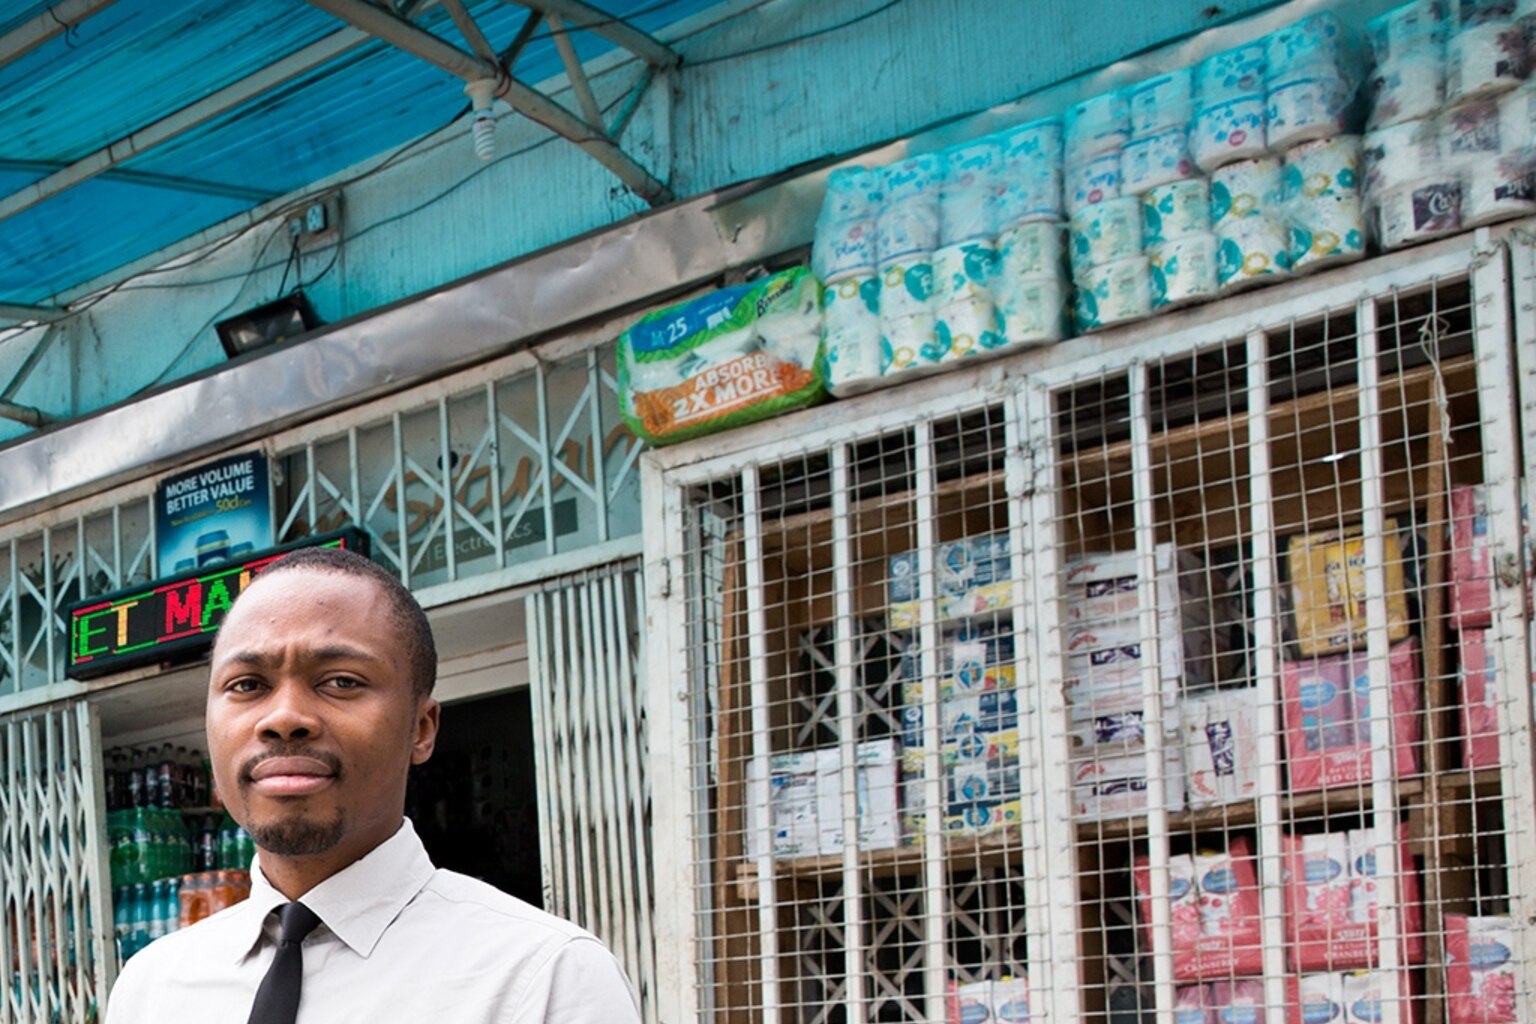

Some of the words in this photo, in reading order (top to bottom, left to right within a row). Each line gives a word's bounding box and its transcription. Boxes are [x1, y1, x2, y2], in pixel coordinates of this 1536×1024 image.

[667, 317, 688, 343] 25
[672, 391, 713, 418] 2X
[166, 476, 199, 499] MORE
[199, 460, 254, 486] VOLUME
[166, 488, 210, 516] BETTER
[210, 475, 255, 500] VALUE
